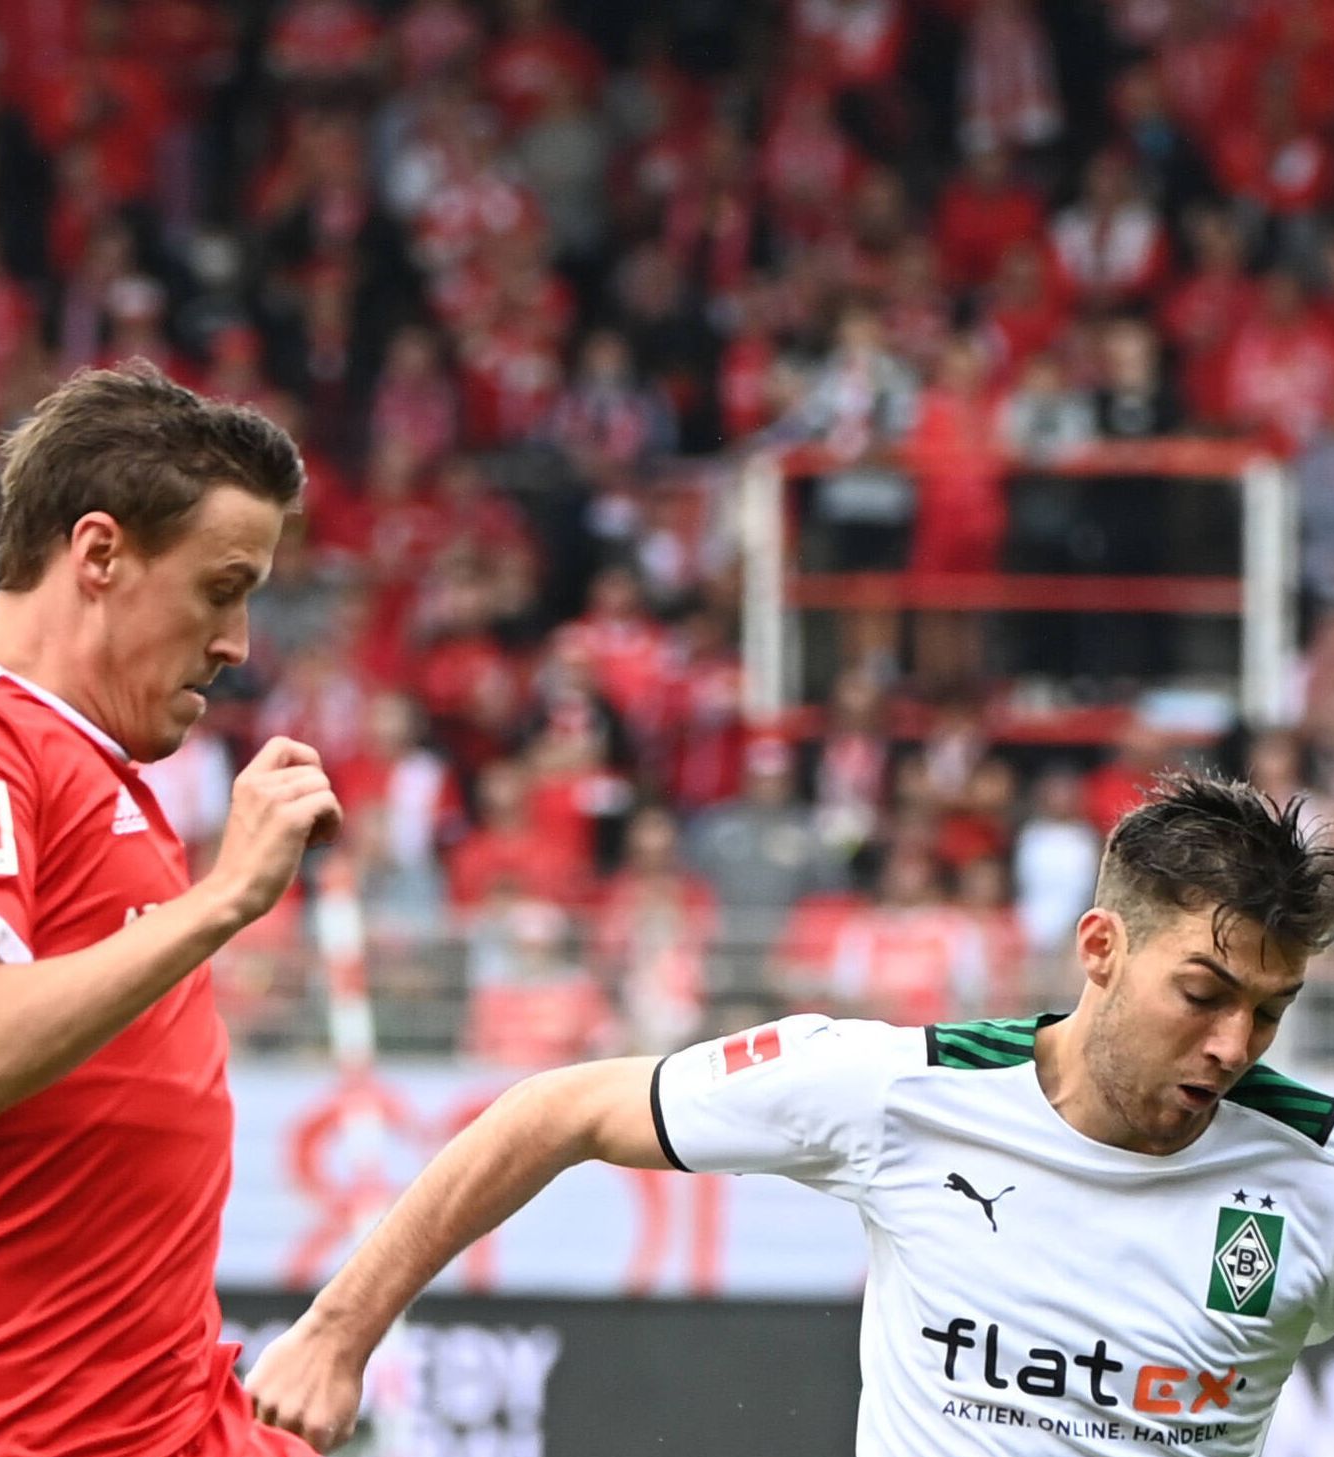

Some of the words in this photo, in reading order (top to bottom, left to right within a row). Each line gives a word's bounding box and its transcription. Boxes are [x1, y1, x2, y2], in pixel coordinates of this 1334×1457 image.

[942, 1400, 1031, 1428] AKTIEN.
[1038, 1417, 1126, 1441] ONLINE.
[1133, 1423, 1229, 1446] HANDELN.
